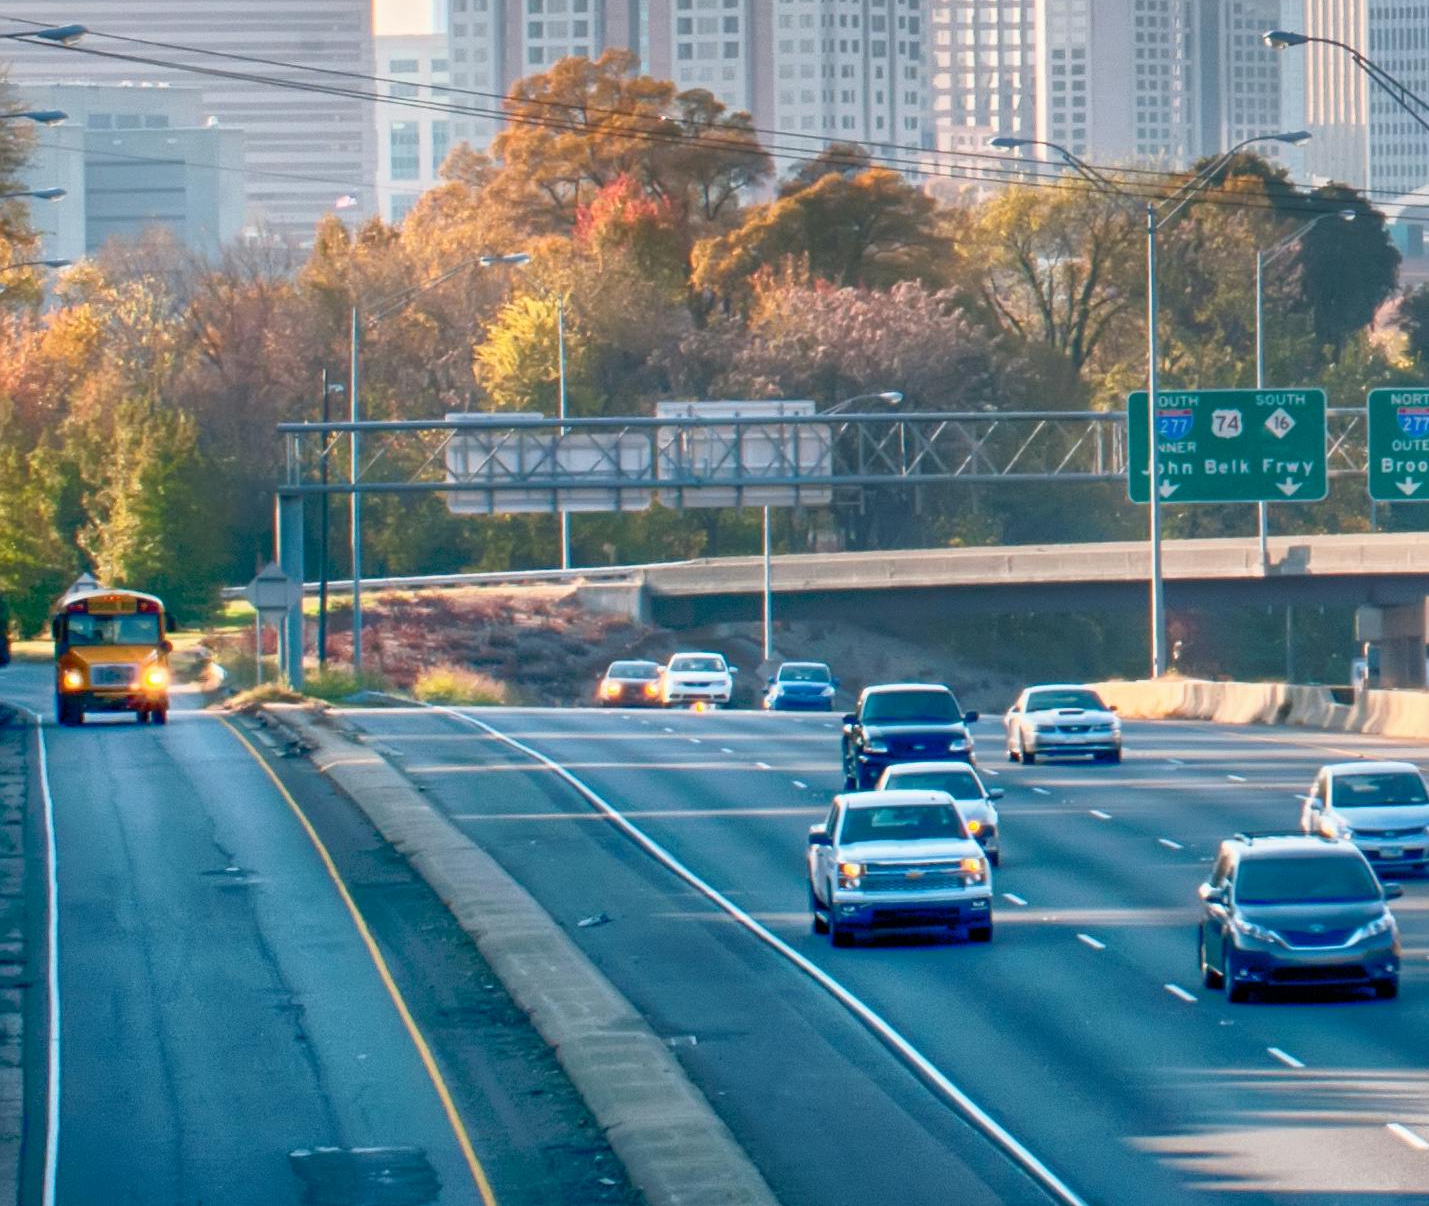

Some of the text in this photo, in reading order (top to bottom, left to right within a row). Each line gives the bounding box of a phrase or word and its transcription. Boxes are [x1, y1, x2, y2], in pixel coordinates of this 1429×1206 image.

[1158, 396, 1199, 408] OUTH
[1255, 394, 1306, 406] SOUTH
[1160, 419, 1188, 434] 277
[1215, 415, 1239, 432] 74
[1273, 416, 1290, 430] 16
[1158, 442, 1197, 453] NNER
[1204, 459, 1249, 475] Belk
[1262, 458, 1314, 477] Frwy
